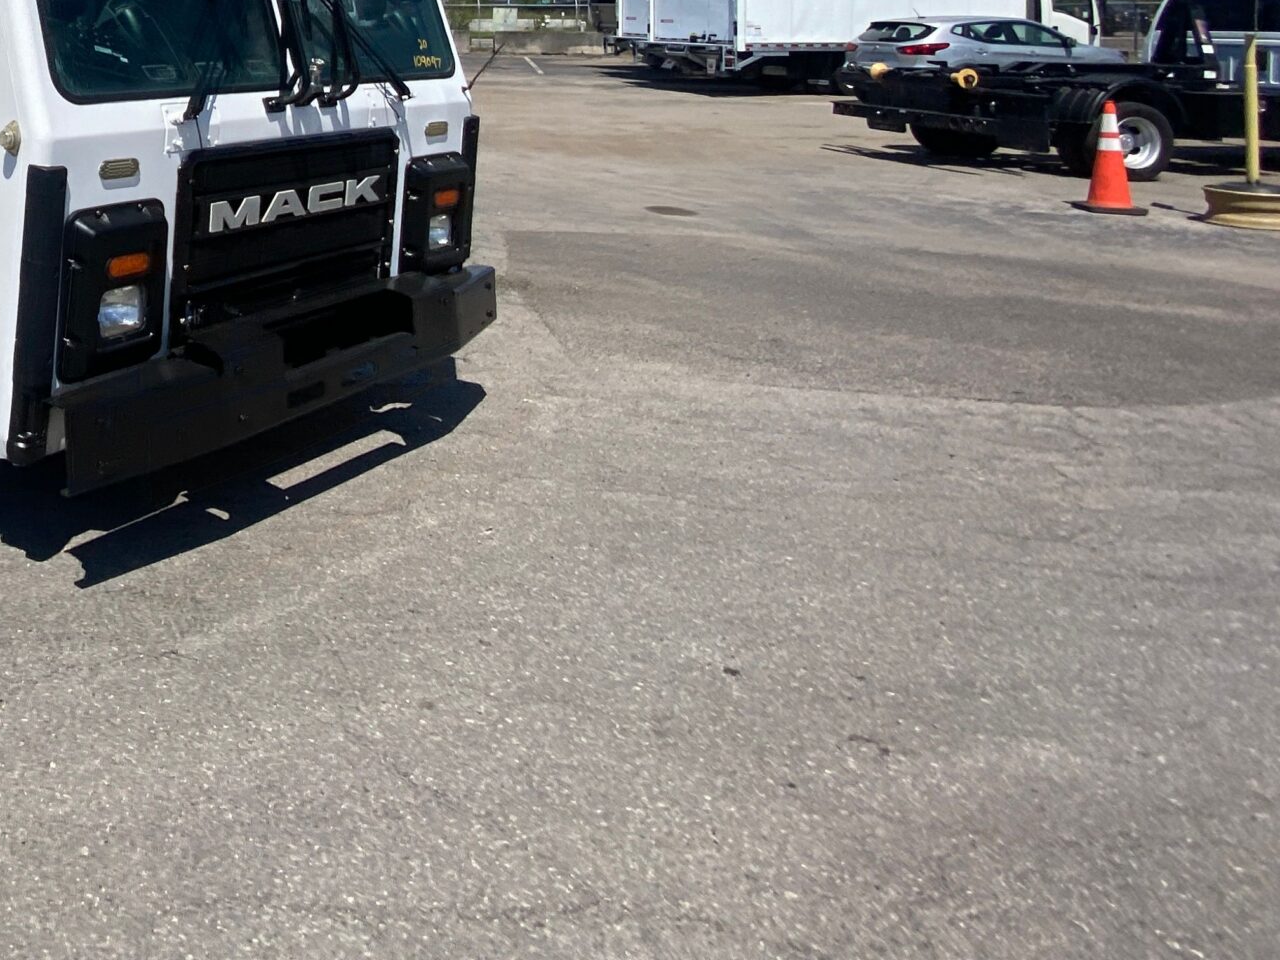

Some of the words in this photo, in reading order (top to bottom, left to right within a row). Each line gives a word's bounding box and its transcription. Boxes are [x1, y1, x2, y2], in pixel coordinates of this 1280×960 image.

[418, 39, 427, 49] 20
[413, 55, 442, 69] 109097
[208, 175, 381, 233] MACK
